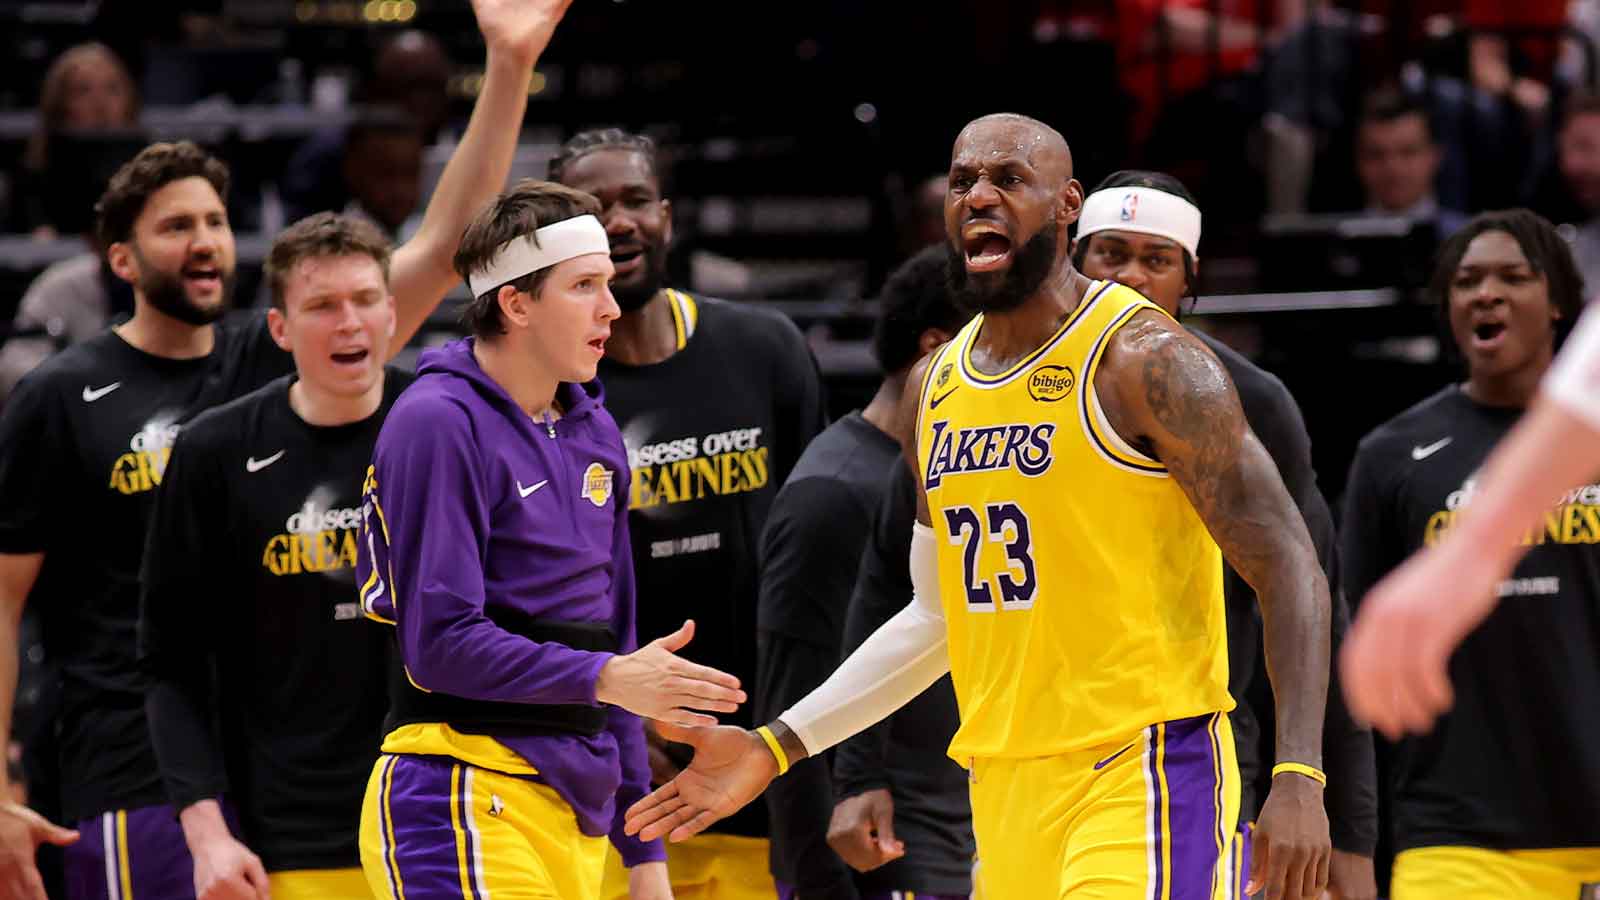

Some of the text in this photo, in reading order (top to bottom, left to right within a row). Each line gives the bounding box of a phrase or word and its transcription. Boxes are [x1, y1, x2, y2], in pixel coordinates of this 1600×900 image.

[1032, 375, 1072, 392] bibigo
[703, 427, 762, 457] over
[925, 420, 1056, 491] LAKERS
[942, 501, 1038, 611] 23
